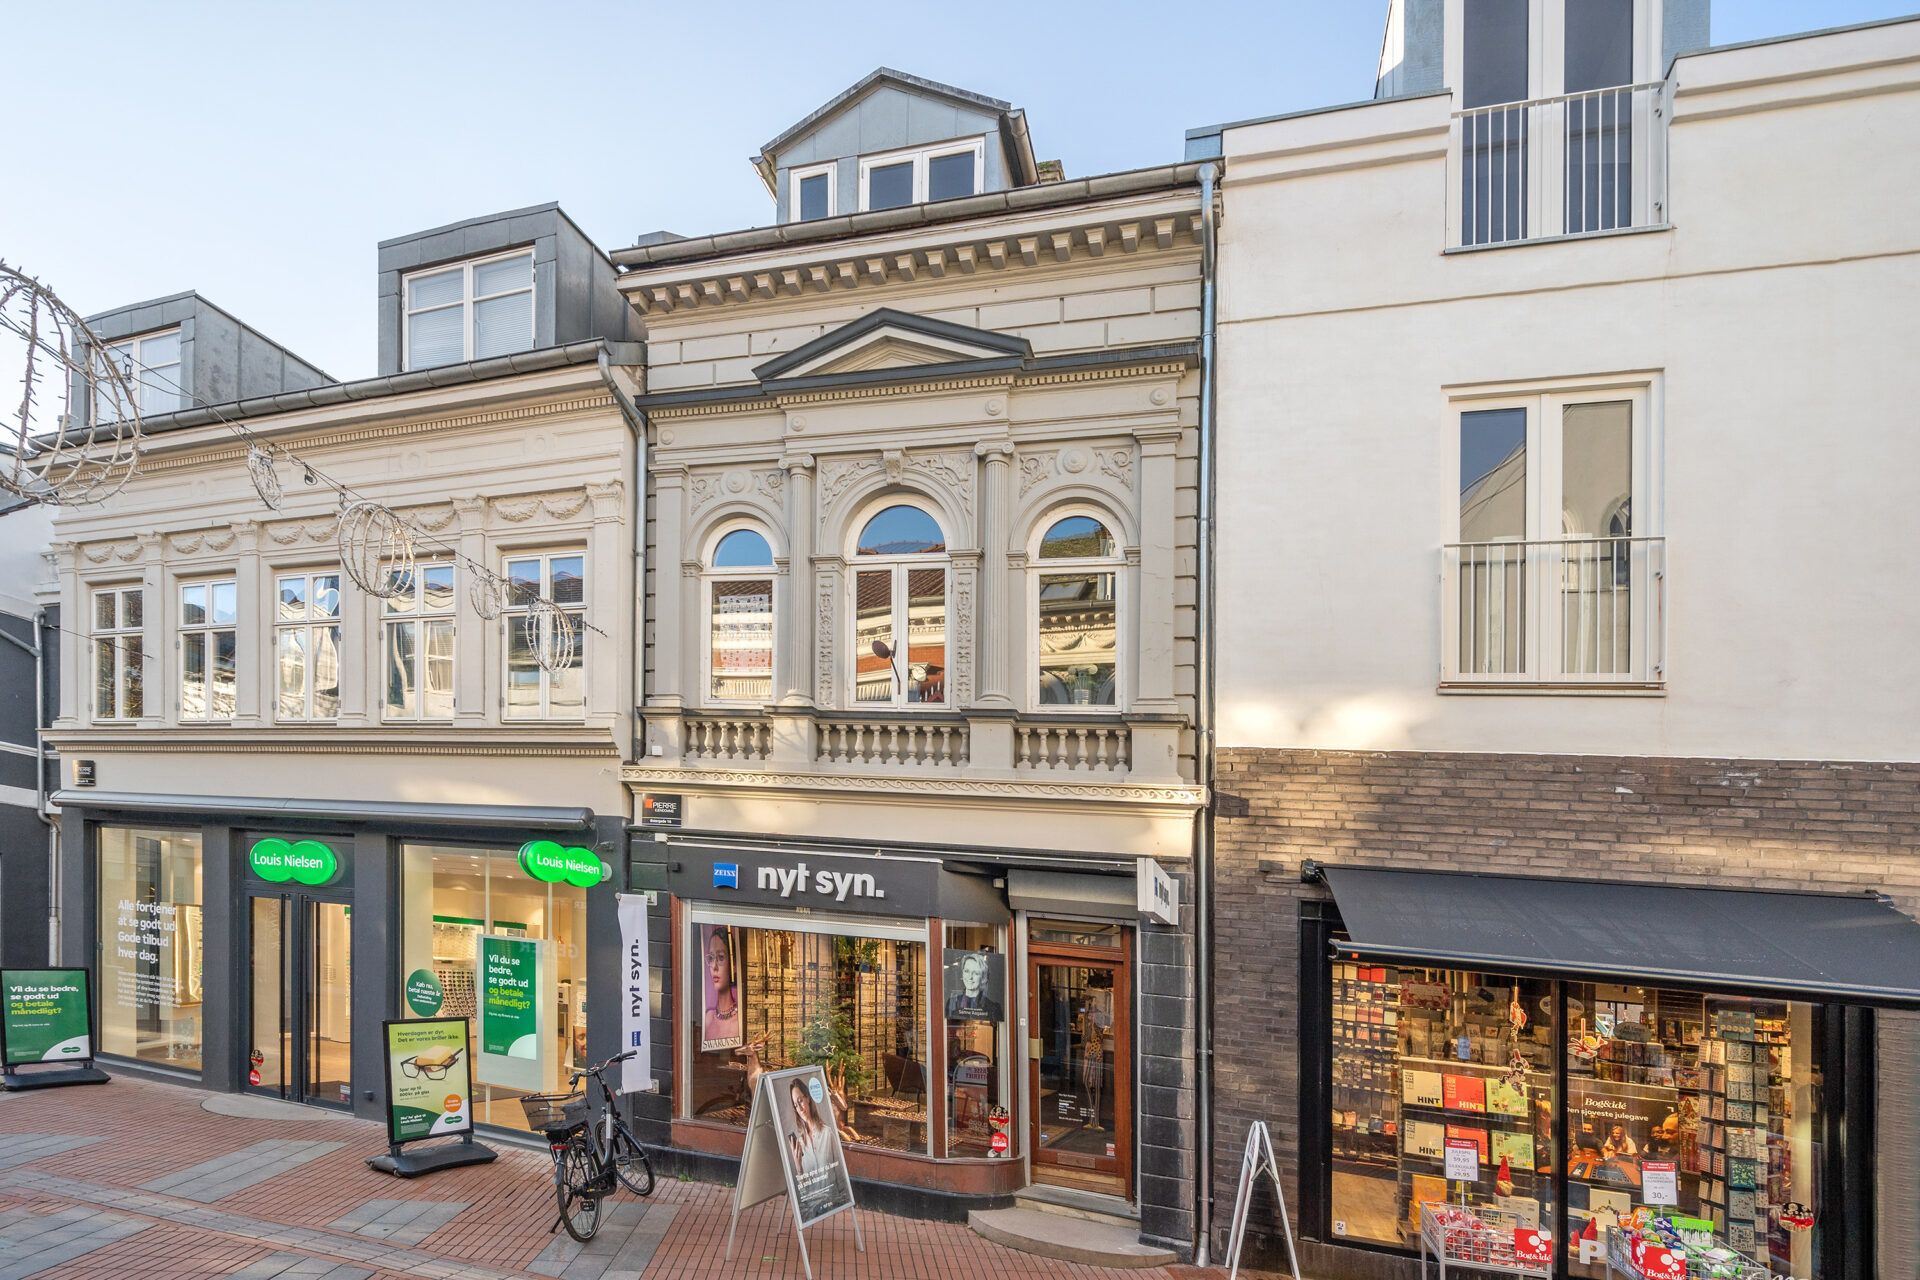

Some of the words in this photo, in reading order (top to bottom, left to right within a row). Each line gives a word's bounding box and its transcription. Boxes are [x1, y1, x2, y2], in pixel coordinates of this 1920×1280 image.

[652, 802, 677, 810] PIERRE
[254, 852, 281, 866] Louis
[284, 854, 323, 869] Nielsen
[537, 853, 563, 869] Louis
[566, 858, 600, 875] Nielsen
[714, 869, 736, 877] ZEISS
[758, 862, 810, 897] nyt
[815, 870, 884, 902] syn.
[118, 900, 134, 911] Alle
[136, 900, 176, 916] fortjener
[118, 916, 127, 926] at
[129, 918, 139, 927] se
[140, 919, 161, 931] godt
[118, 931, 141, 944] Gode
[142, 933, 168, 947] tilbud
[118, 946, 137, 958] hver
[140, 950, 159, 964] dag.
[488, 954, 498, 963] Vil
[500, 955, 510, 964] du
[630, 939, 642, 980] syn.
[488, 965, 512, 976] bedre,
[499, 978, 517, 986] godt
[518, 979, 529, 988] ud
[23, 993, 46, 1001] godt
[488, 987, 498, 996] og
[500, 987, 524, 998] betale
[488, 996, 530, 1010] månedligt?
[629, 985, 642, 1017] nyt
[11, 1007, 62, 1016] månedligt?
[1417, 1096, 1440, 1104] HINT
[1585, 1097, 1627, 1109] Bog&idé
[1614, 1112, 1649, 1121] julegave
[1516, 1250, 1552, 1261] Bog&idé
